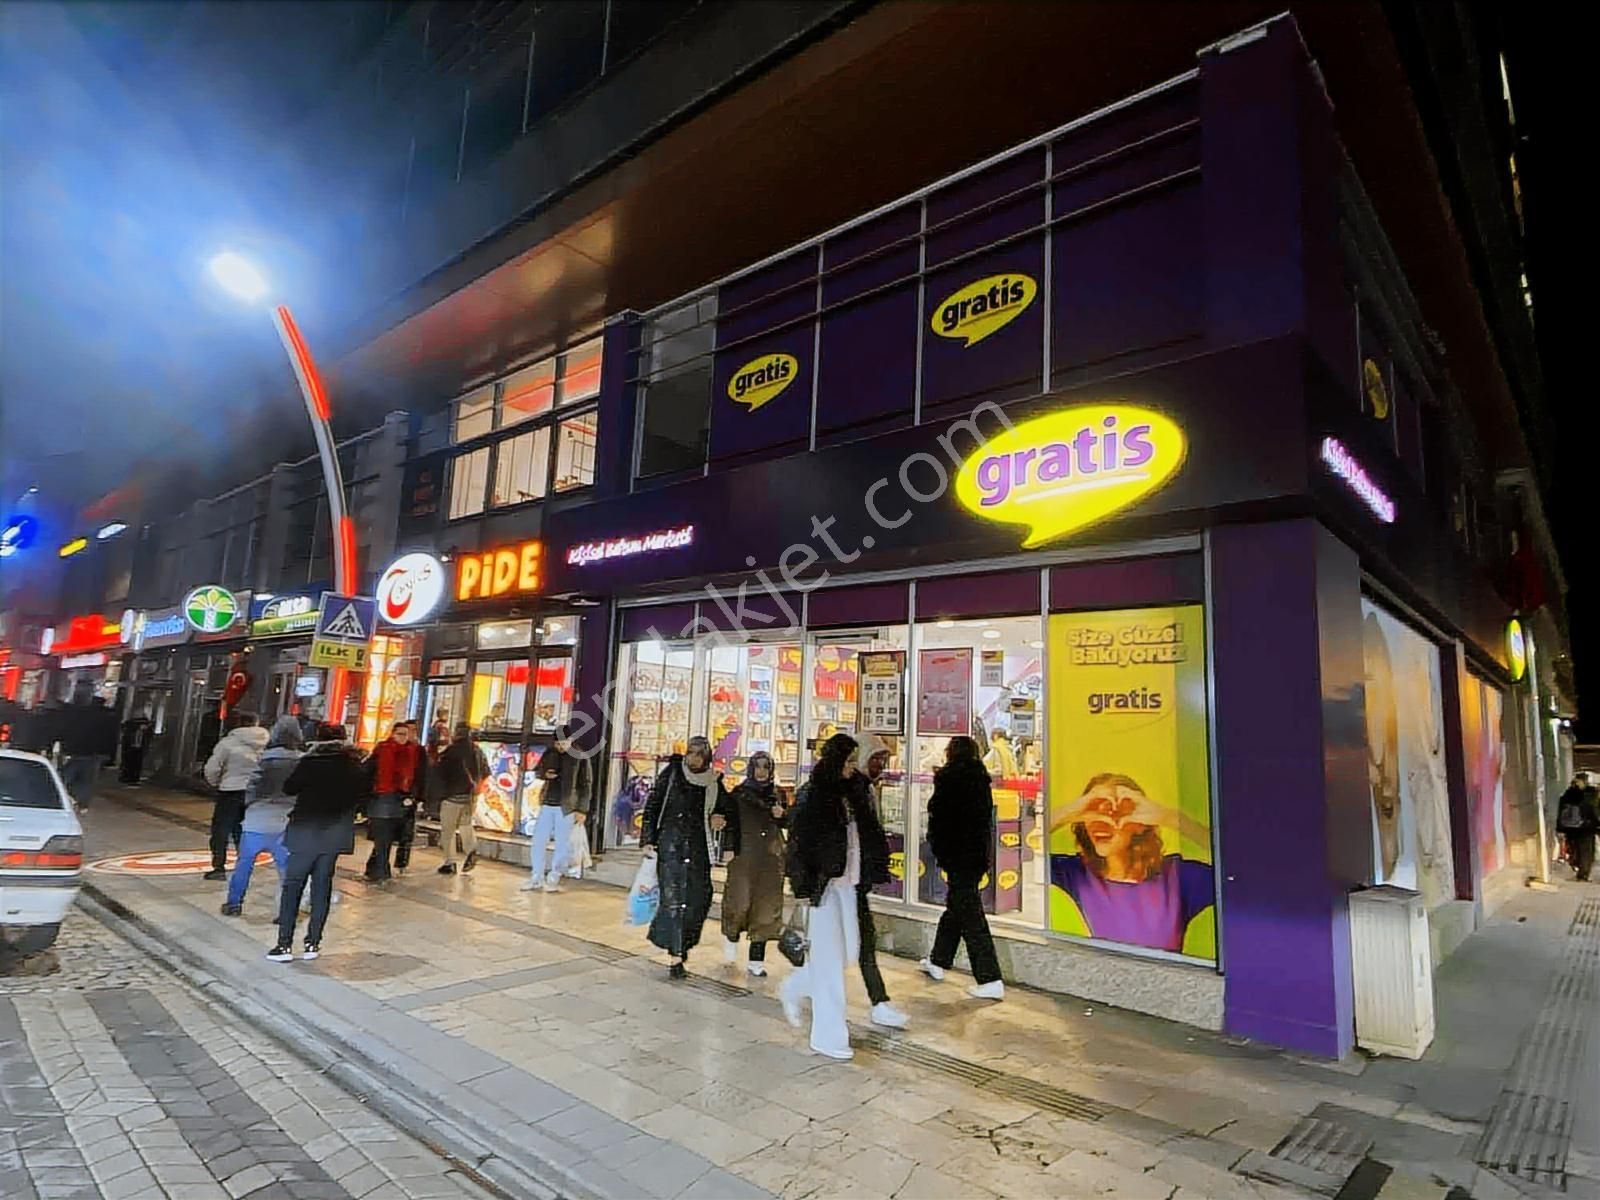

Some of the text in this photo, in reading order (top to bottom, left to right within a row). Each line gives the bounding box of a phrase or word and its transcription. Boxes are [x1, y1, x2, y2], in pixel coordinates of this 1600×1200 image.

[941, 278, 1025, 332] gratis
[735, 357, 790, 397] gratis
[977, 415, 1154, 506] gratis
[1068, 622, 1184, 647] Size Güzel
[1088, 687, 1162, 714] gratis
